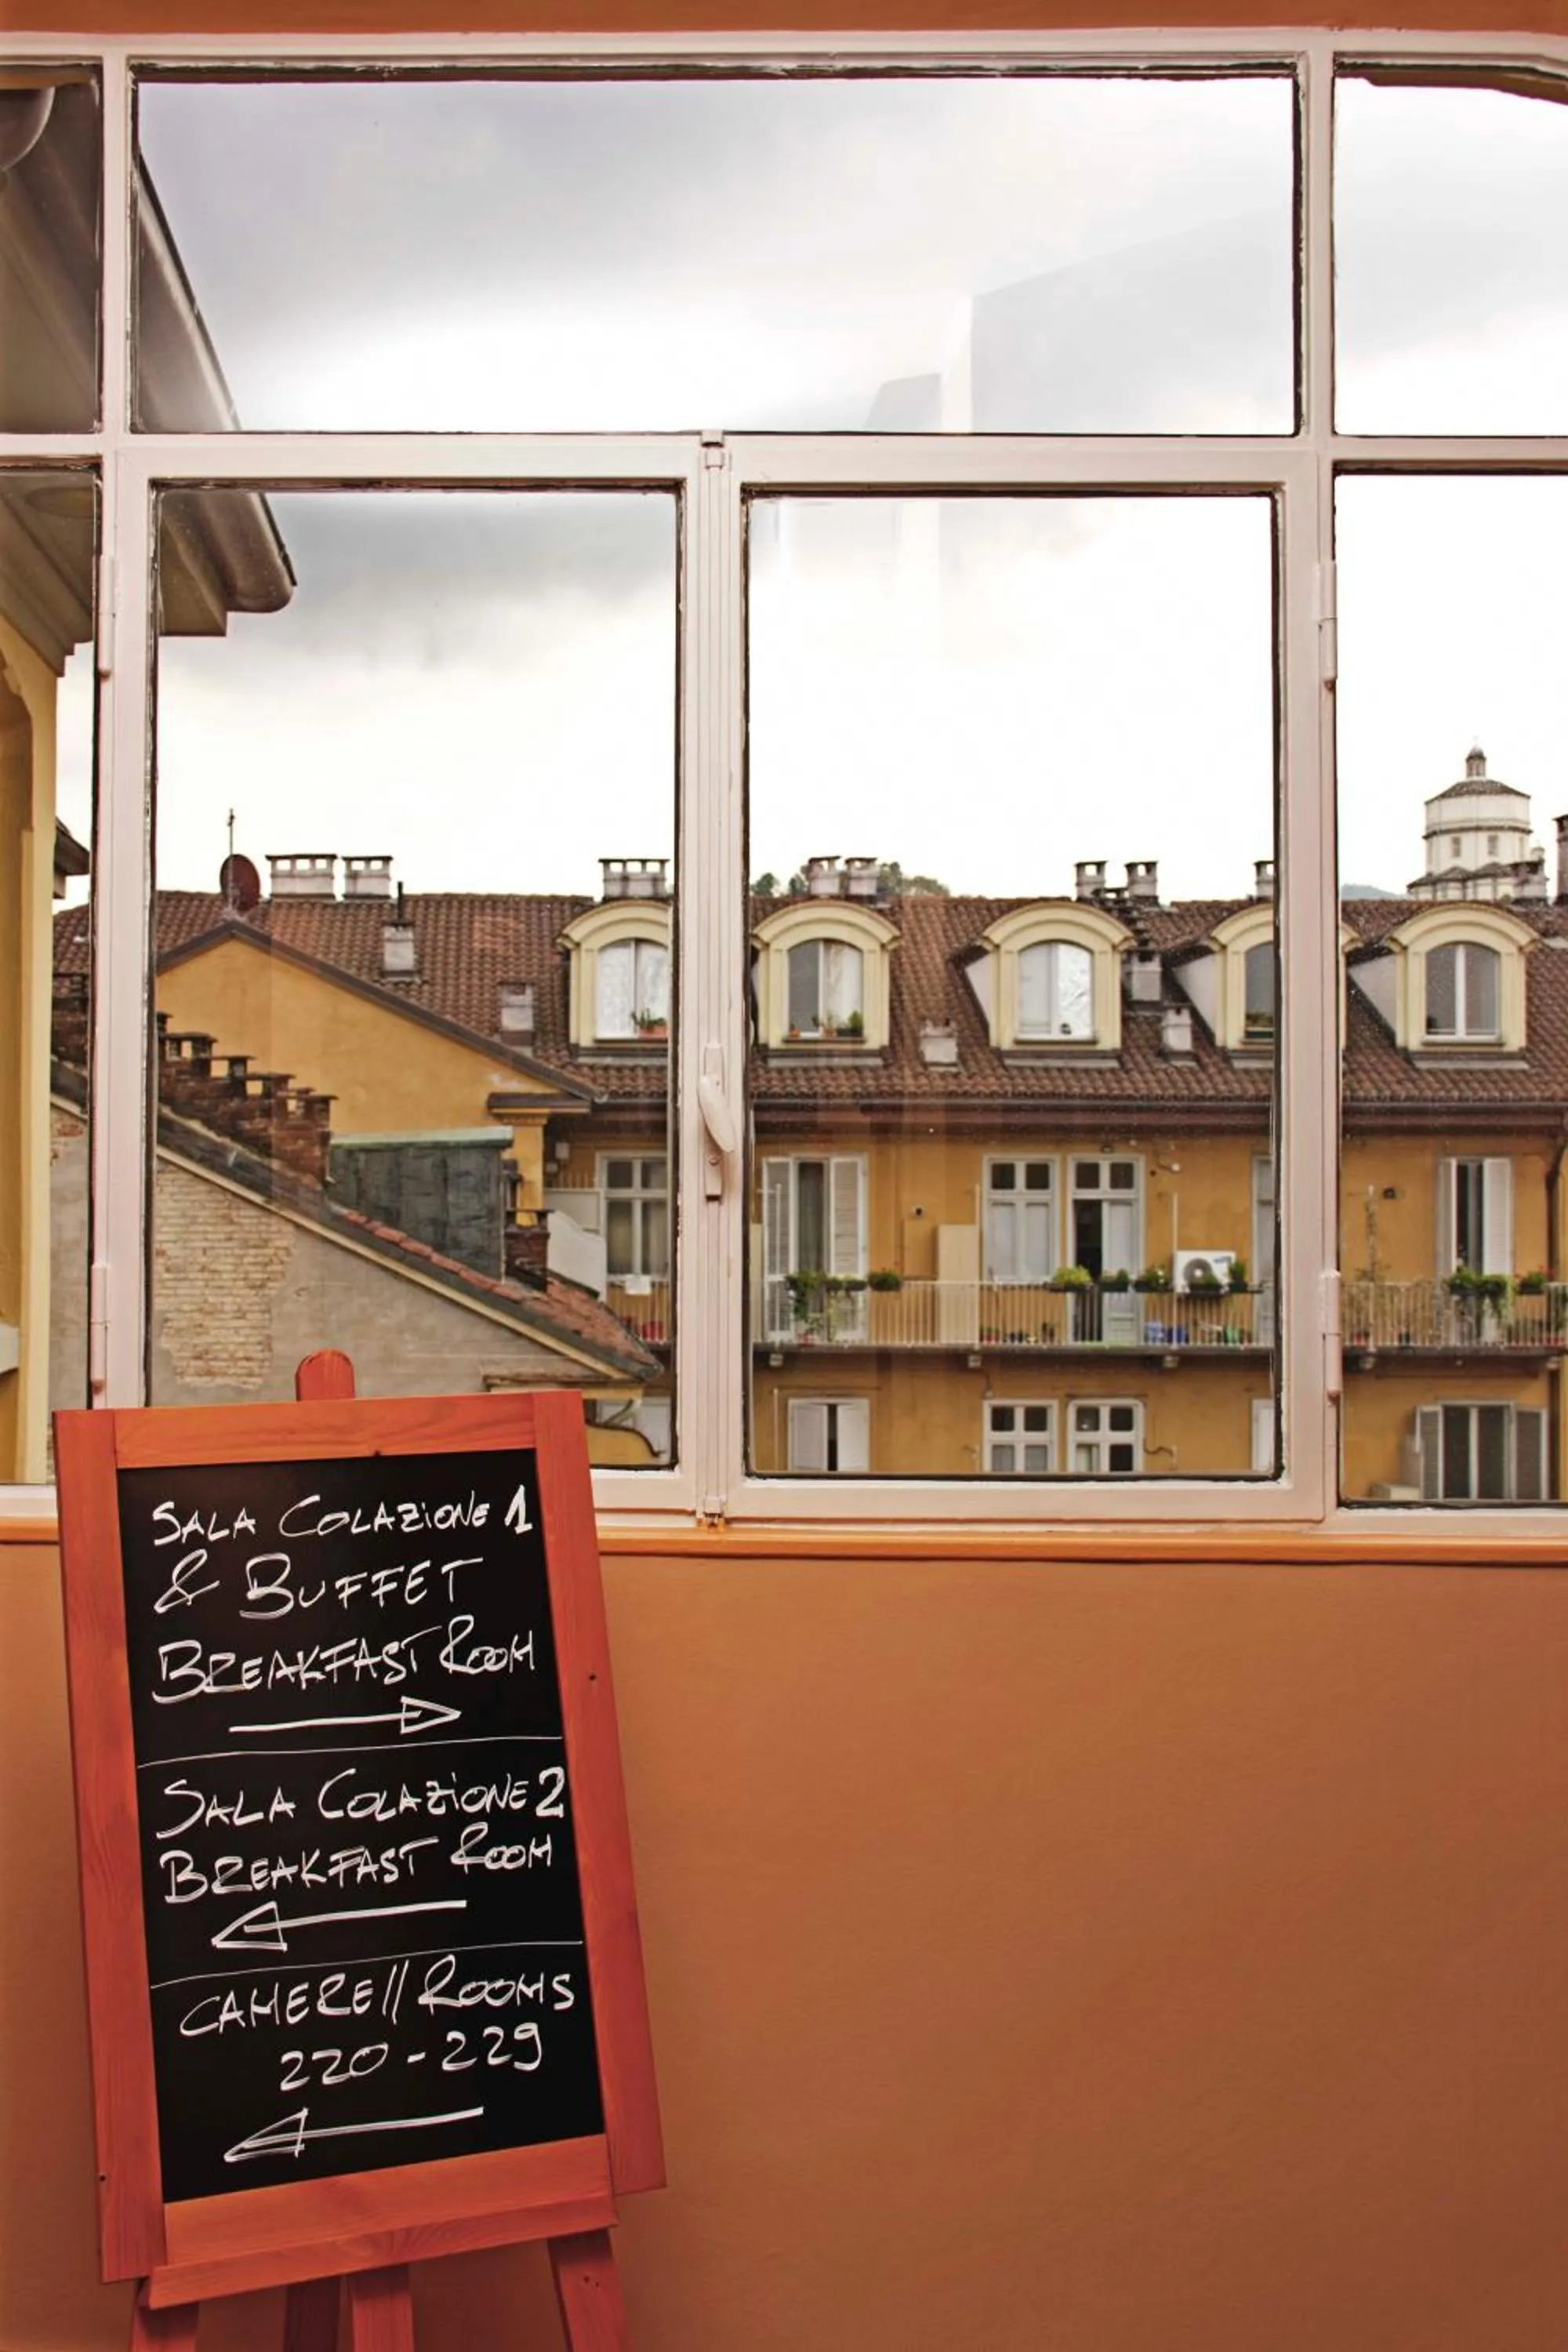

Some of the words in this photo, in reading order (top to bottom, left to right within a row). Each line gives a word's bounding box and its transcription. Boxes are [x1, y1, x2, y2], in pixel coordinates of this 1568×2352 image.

[152, 1501, 256, 1546] SALA
[504, 1484, 533, 1534] 1
[153, 1548, 220, 1614] &
[239, 1552, 484, 1619] BUFFET
[151, 1625, 442, 1704] BREAKFAST
[439, 1614, 535, 1675] ROOM
[156, 1779, 296, 1839] SALA
[535, 1766, 564, 1818] 2
[159, 1838, 440, 1904] BREAKFAST
[450, 1821, 552, 1875] ROOM
[280, 2042, 389, 2091] 220
[441, 2022, 542, 2071] 229
